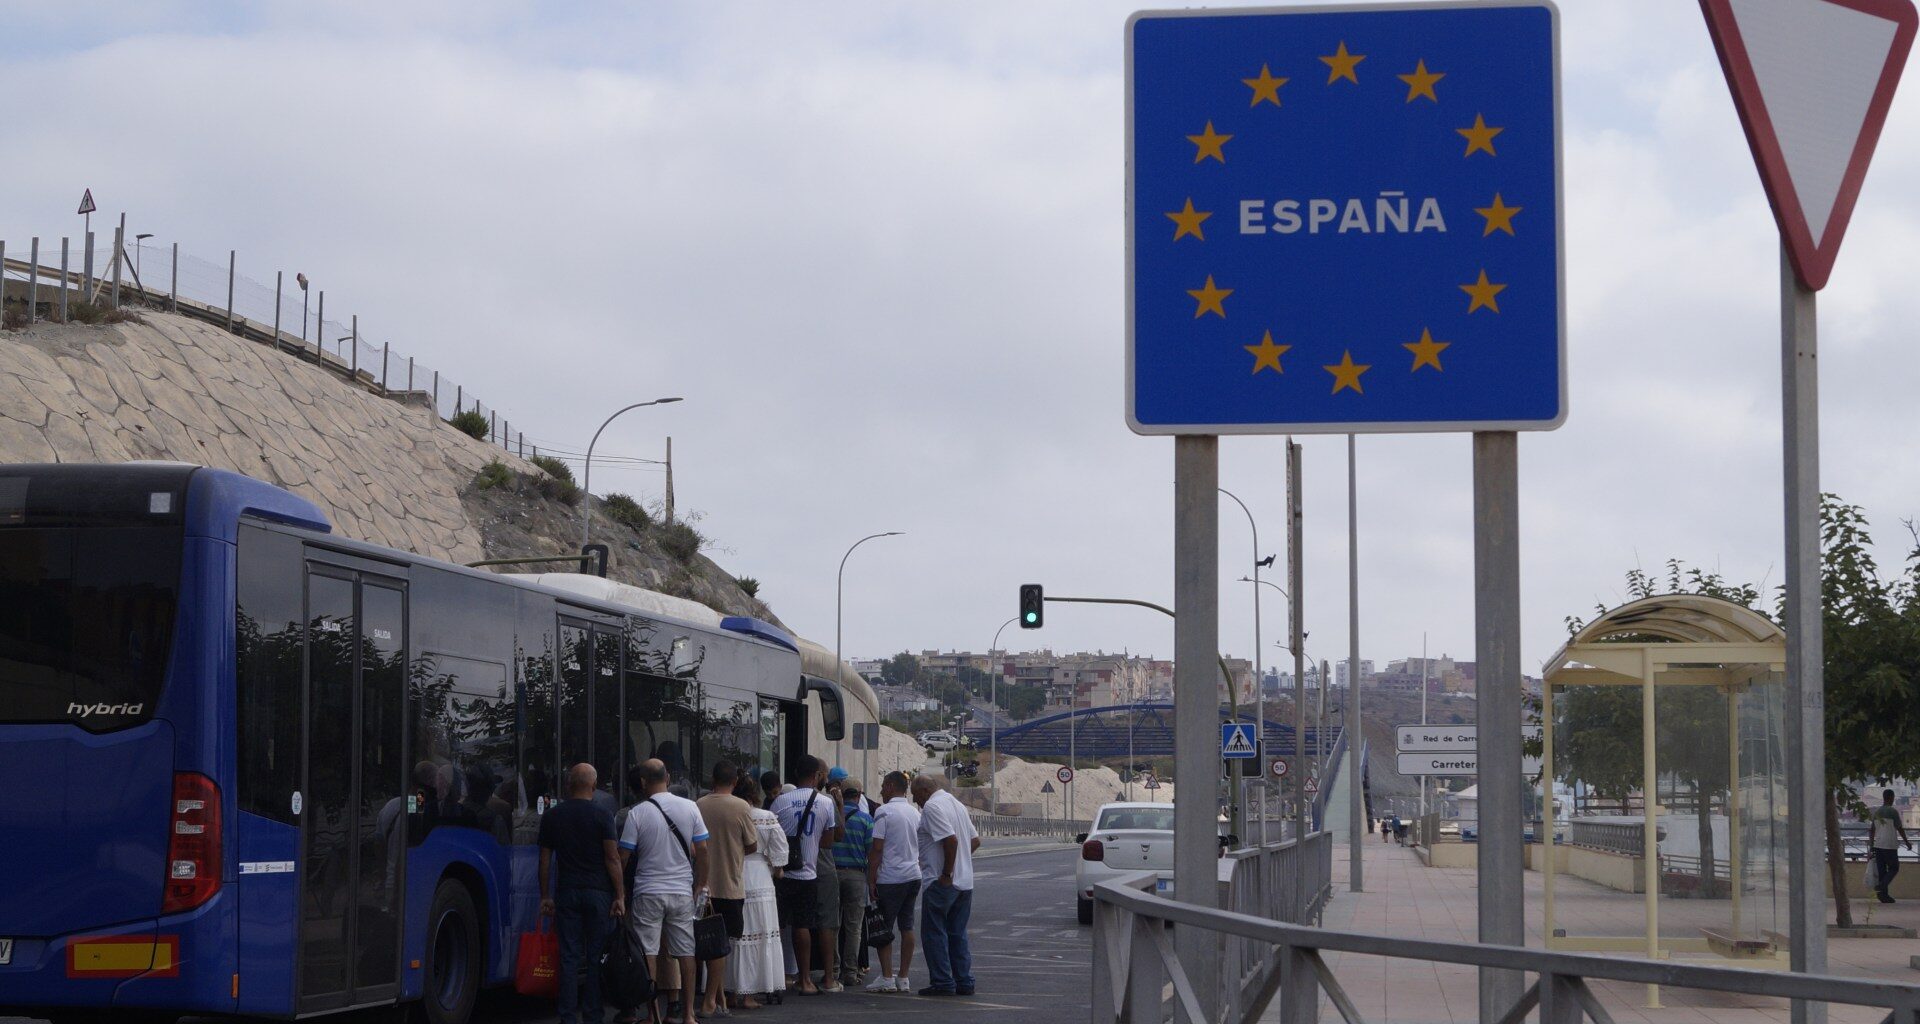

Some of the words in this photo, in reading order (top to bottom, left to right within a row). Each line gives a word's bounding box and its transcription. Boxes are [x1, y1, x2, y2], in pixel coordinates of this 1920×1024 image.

[1240, 191, 1447, 234] ESPAÑA
[322, 620, 341, 632] SALIDA
[373, 628, 391, 640] SALIDA
[67, 702, 143, 717] hybrid
[1431, 760, 1478, 769] Carreter
